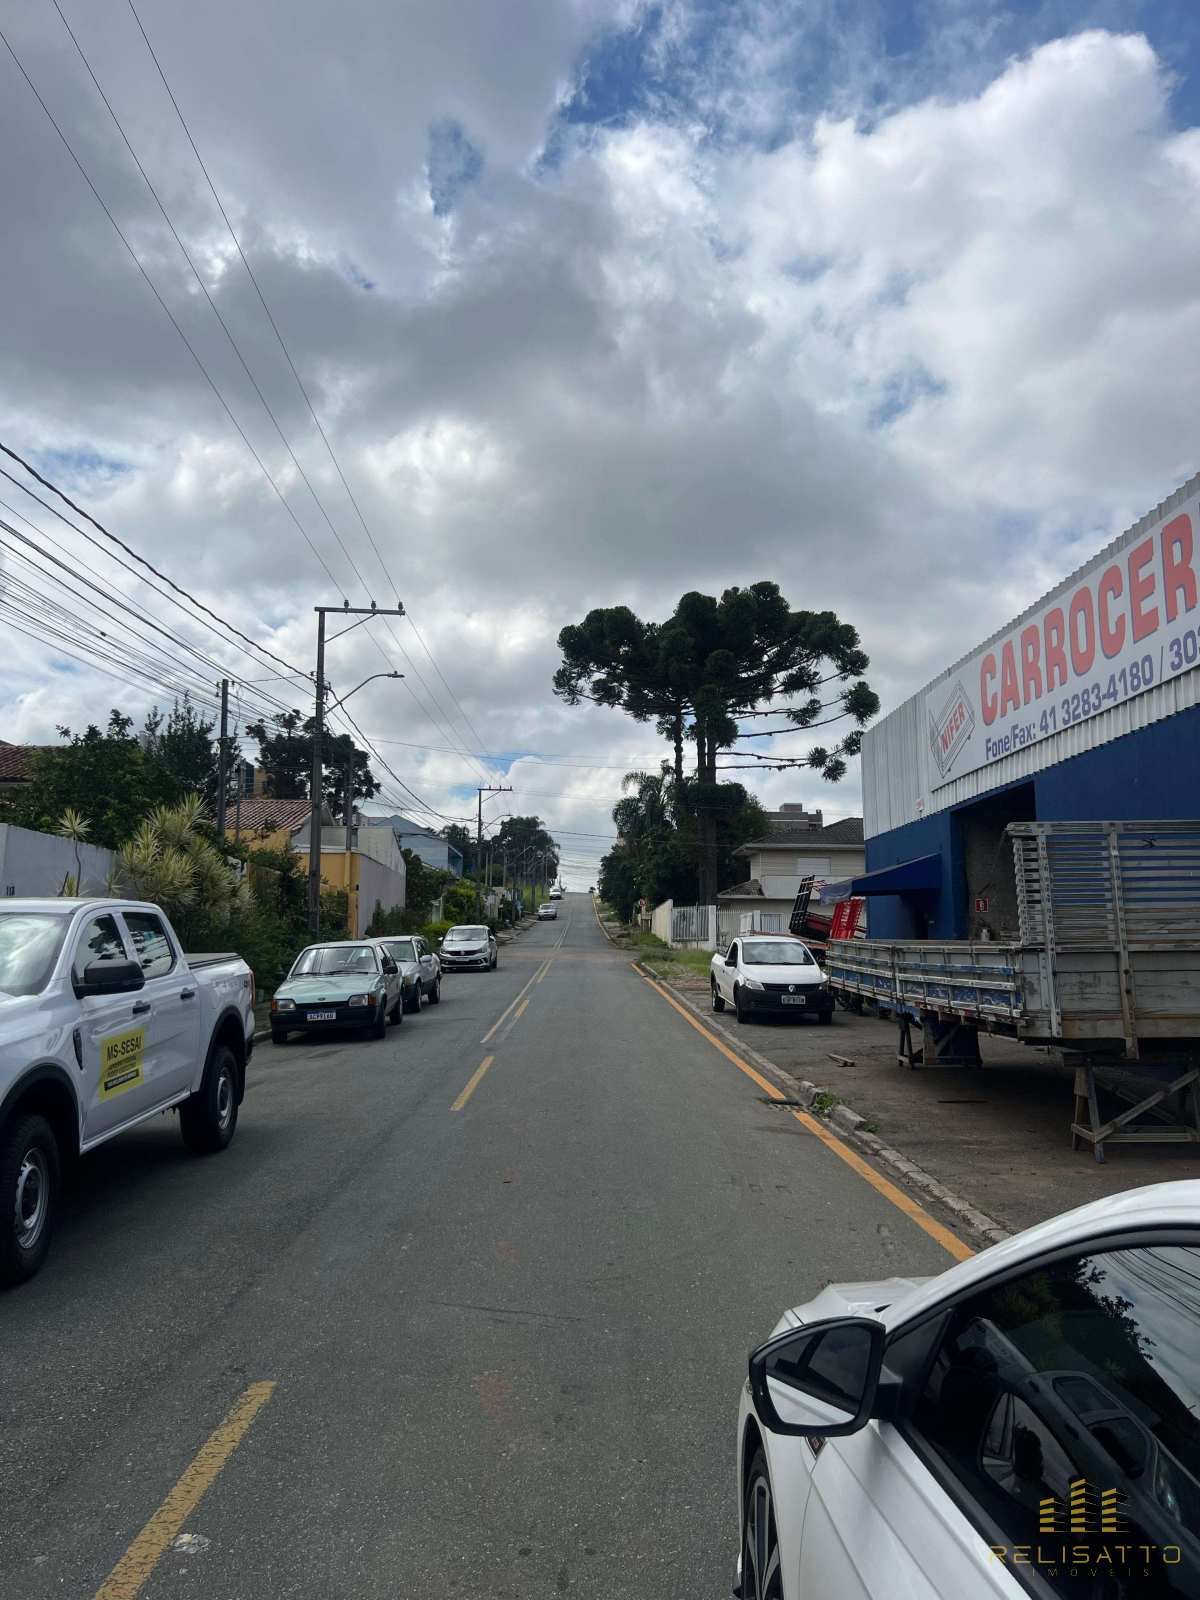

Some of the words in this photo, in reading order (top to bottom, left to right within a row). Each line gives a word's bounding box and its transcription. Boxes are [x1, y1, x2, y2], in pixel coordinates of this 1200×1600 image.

[980, 500, 1200, 726] CARROCER
[985, 723, 1035, 760] Fone/Fax:
[1039, 704, 1057, 734] 41
[1061, 654, 1154, 726] 3283-4180
[1169, 625, 1200, 671] 30
[107, 1036, 142, 1061] MS-SESAI
